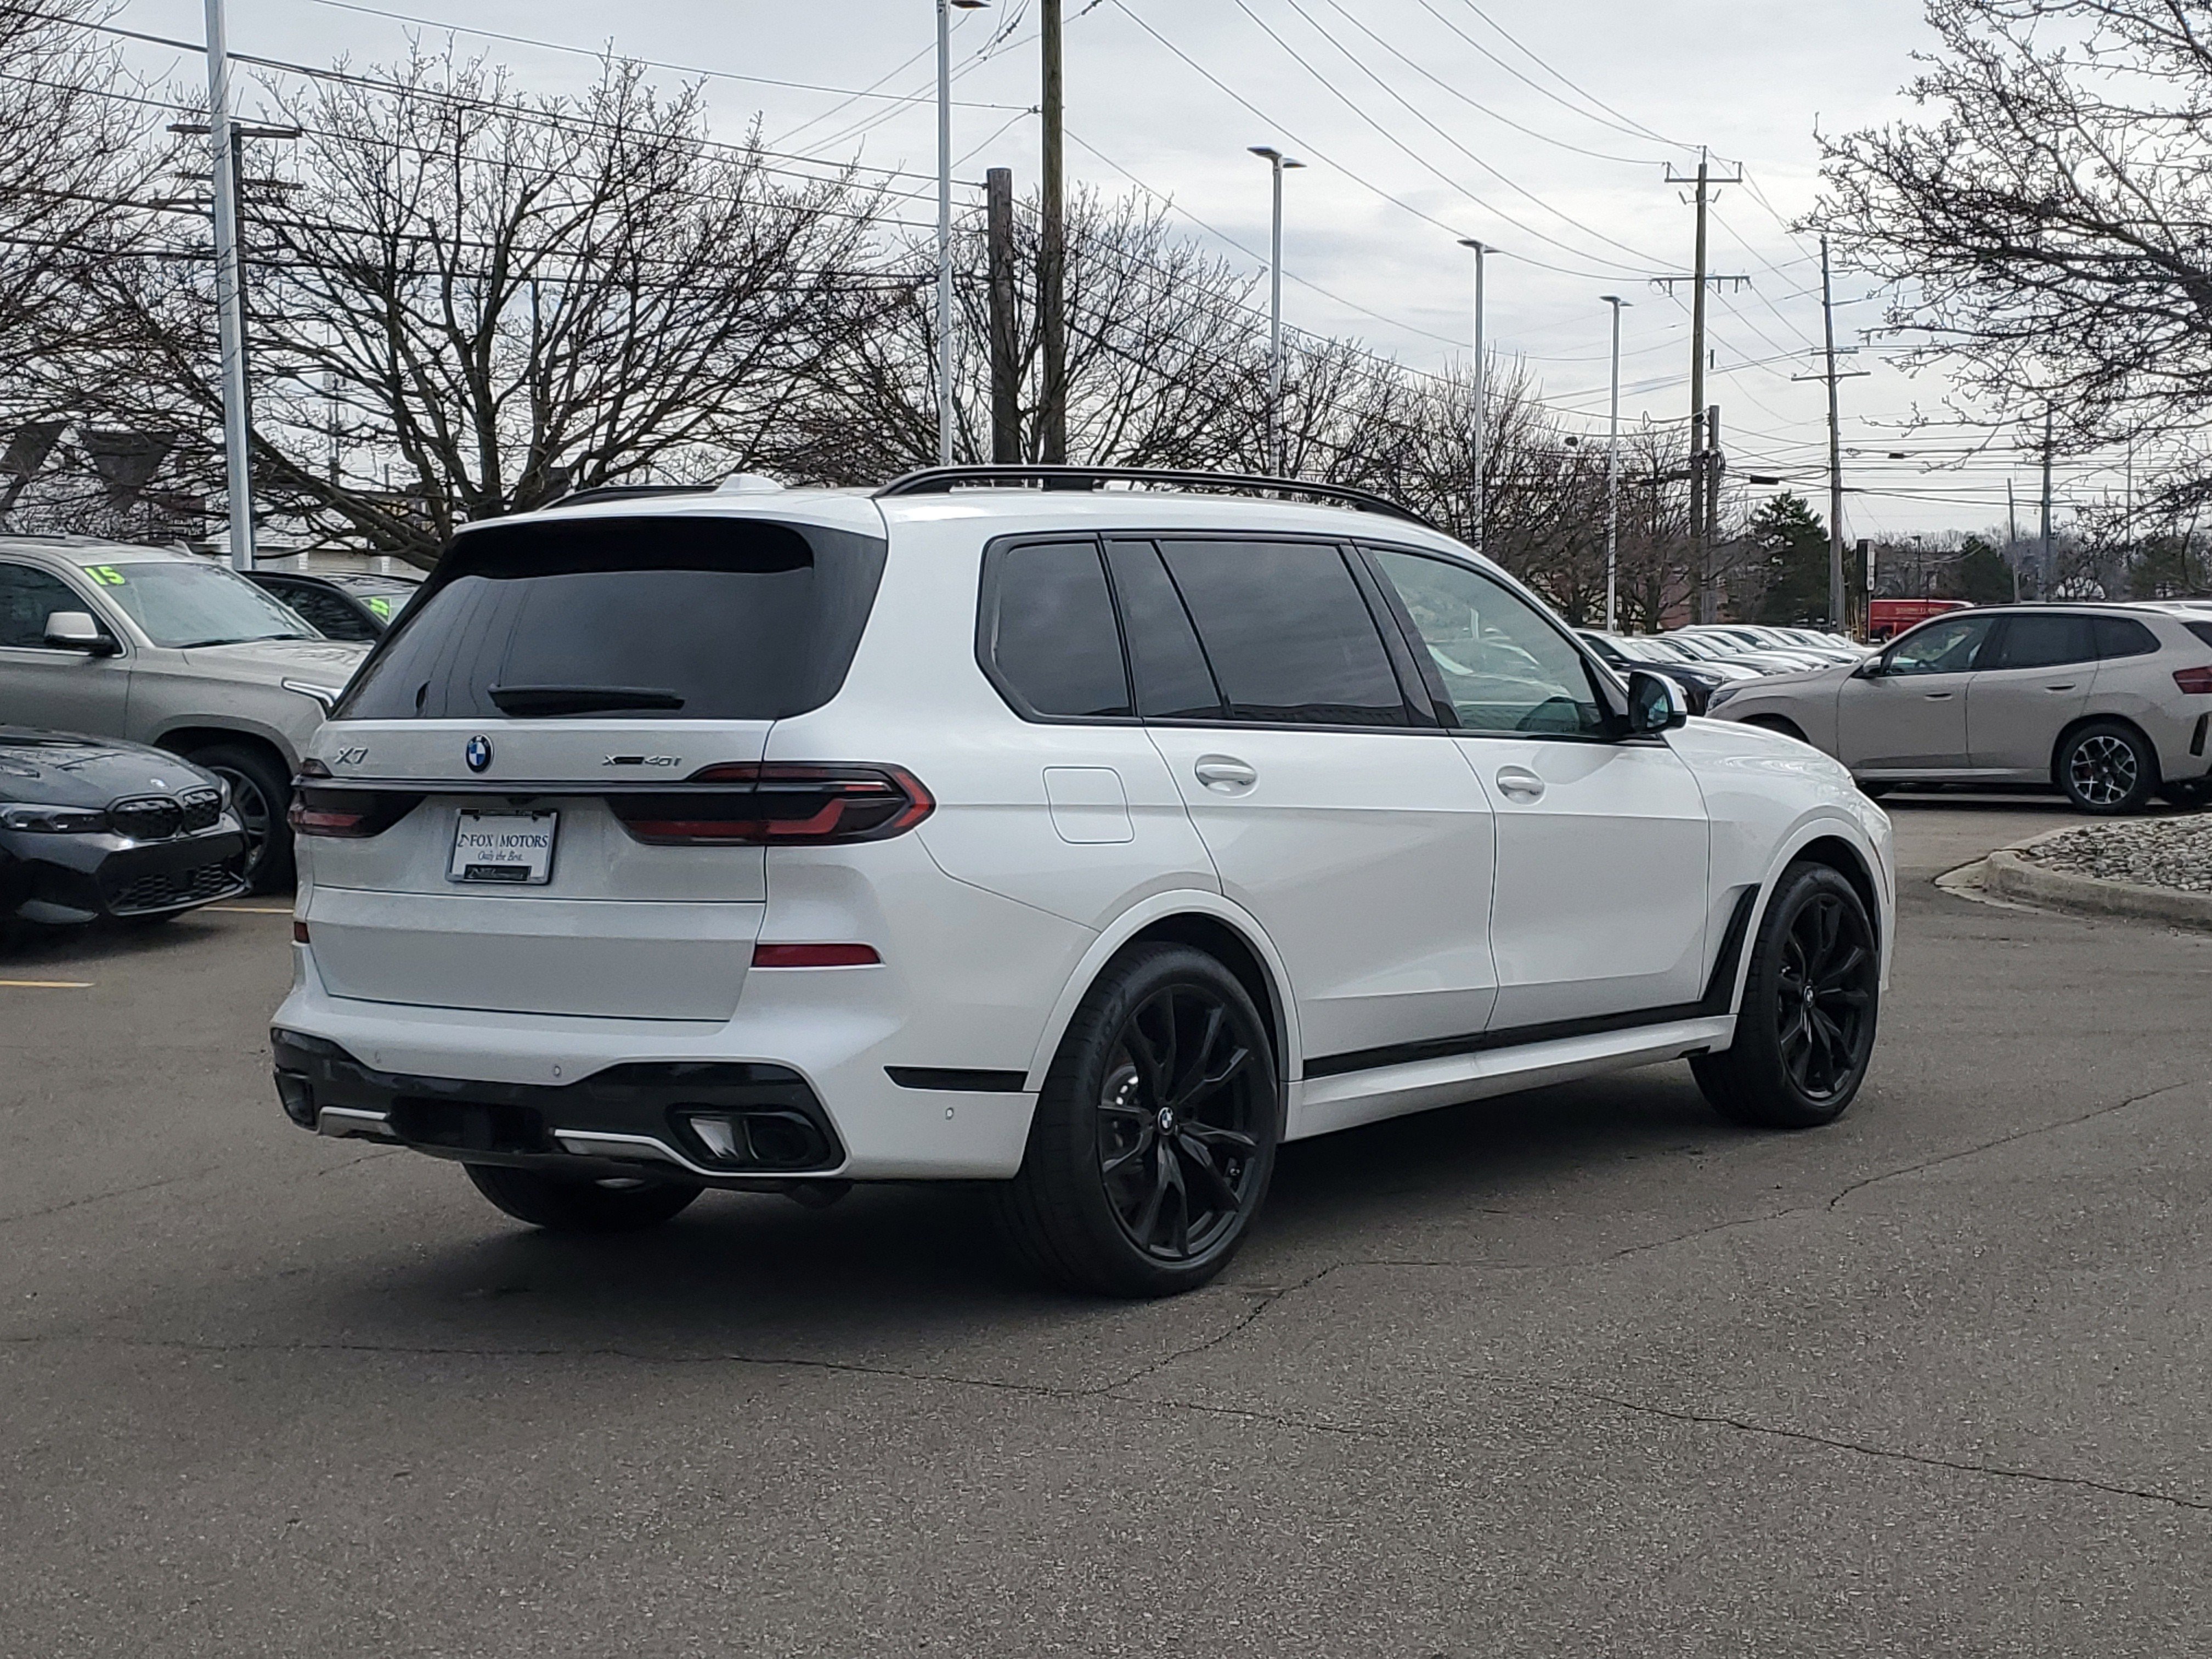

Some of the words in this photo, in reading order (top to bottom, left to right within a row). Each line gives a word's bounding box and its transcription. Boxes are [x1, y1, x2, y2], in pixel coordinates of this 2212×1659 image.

[84, 566, 126, 585] 15
[334, 747, 369, 765] X7
[470, 834, 493, 847] FOX
[499, 834, 549, 848] MOTORS
